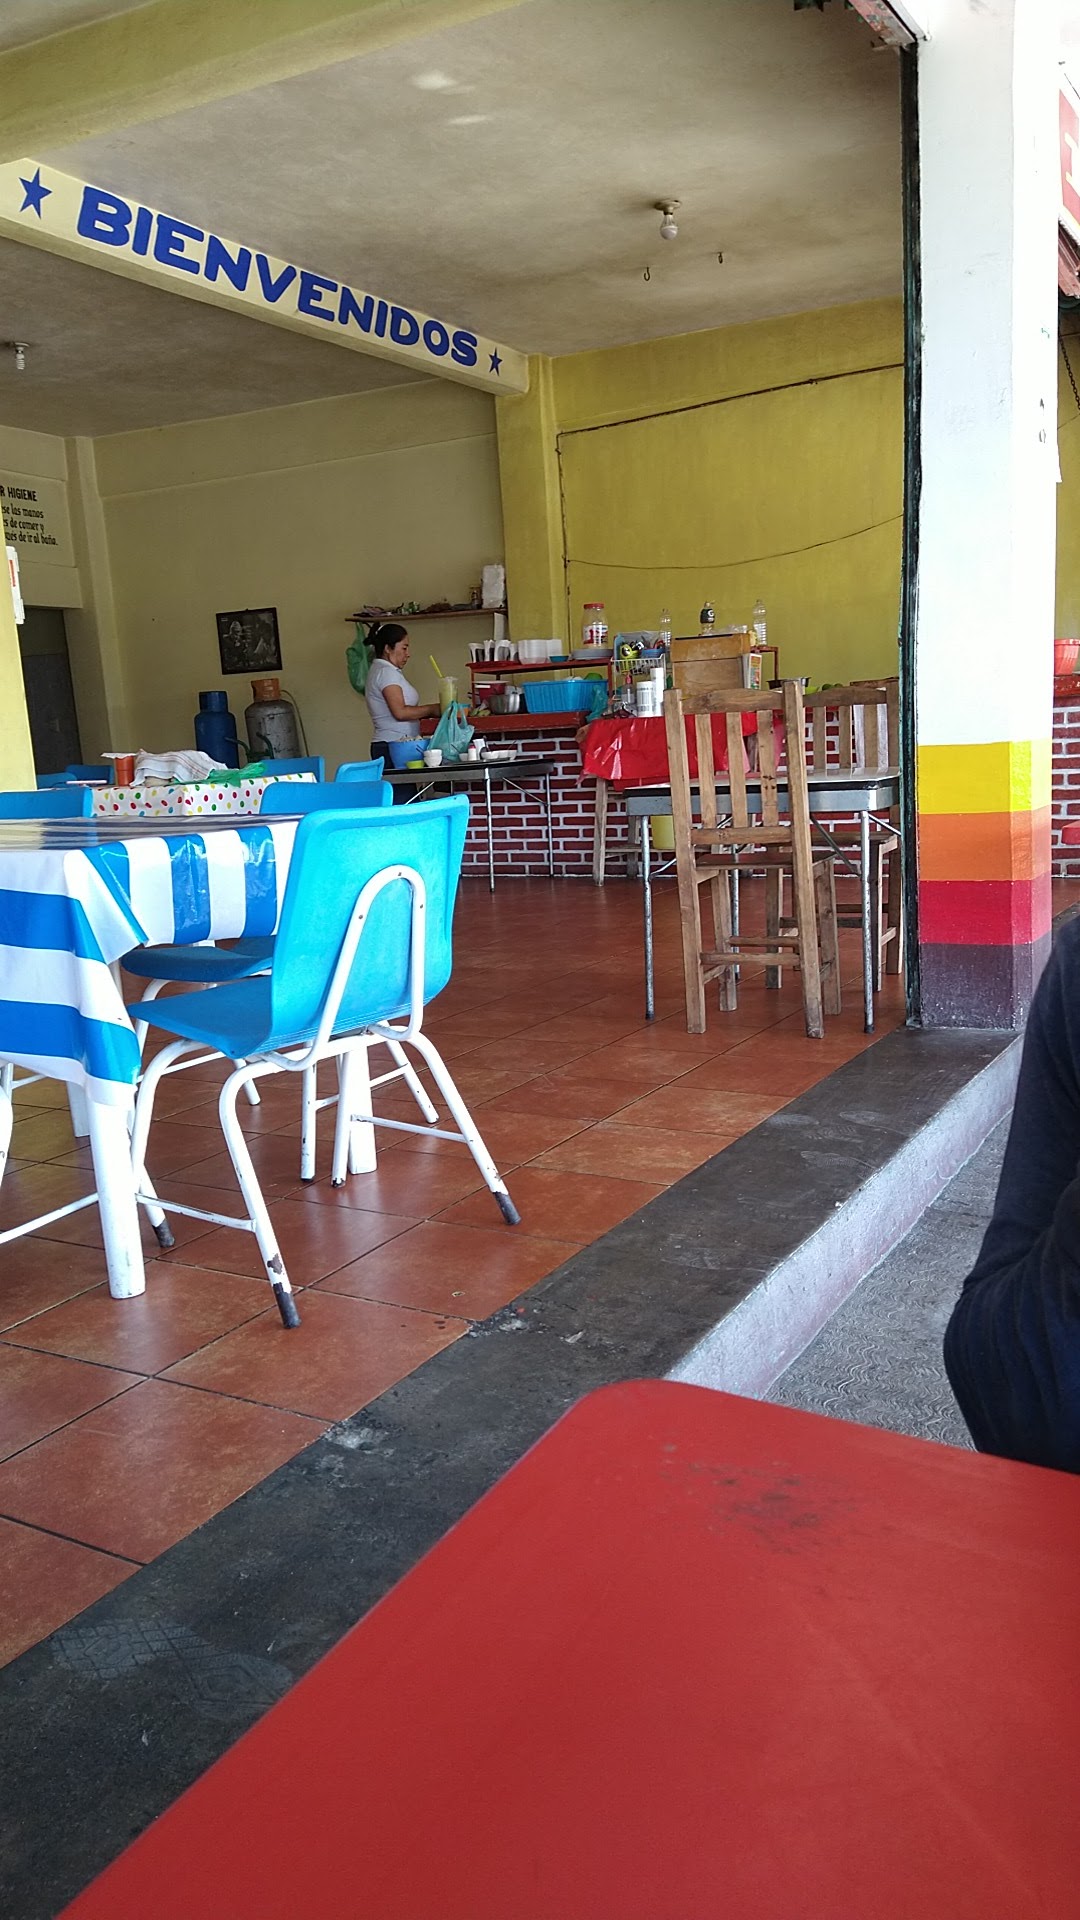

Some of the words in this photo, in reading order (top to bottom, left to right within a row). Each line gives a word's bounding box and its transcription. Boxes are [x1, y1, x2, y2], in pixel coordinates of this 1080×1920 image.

[77, 185, 478, 367] BIENVENIDOS
[7, 486, 38, 501] HIGIENE
[22, 508, 44, 519] manos
[10, 516, 18, 529] de
[18, 521, 39, 531] comer
[40, 523, 45, 534] y
[18, 530, 26, 543] de
